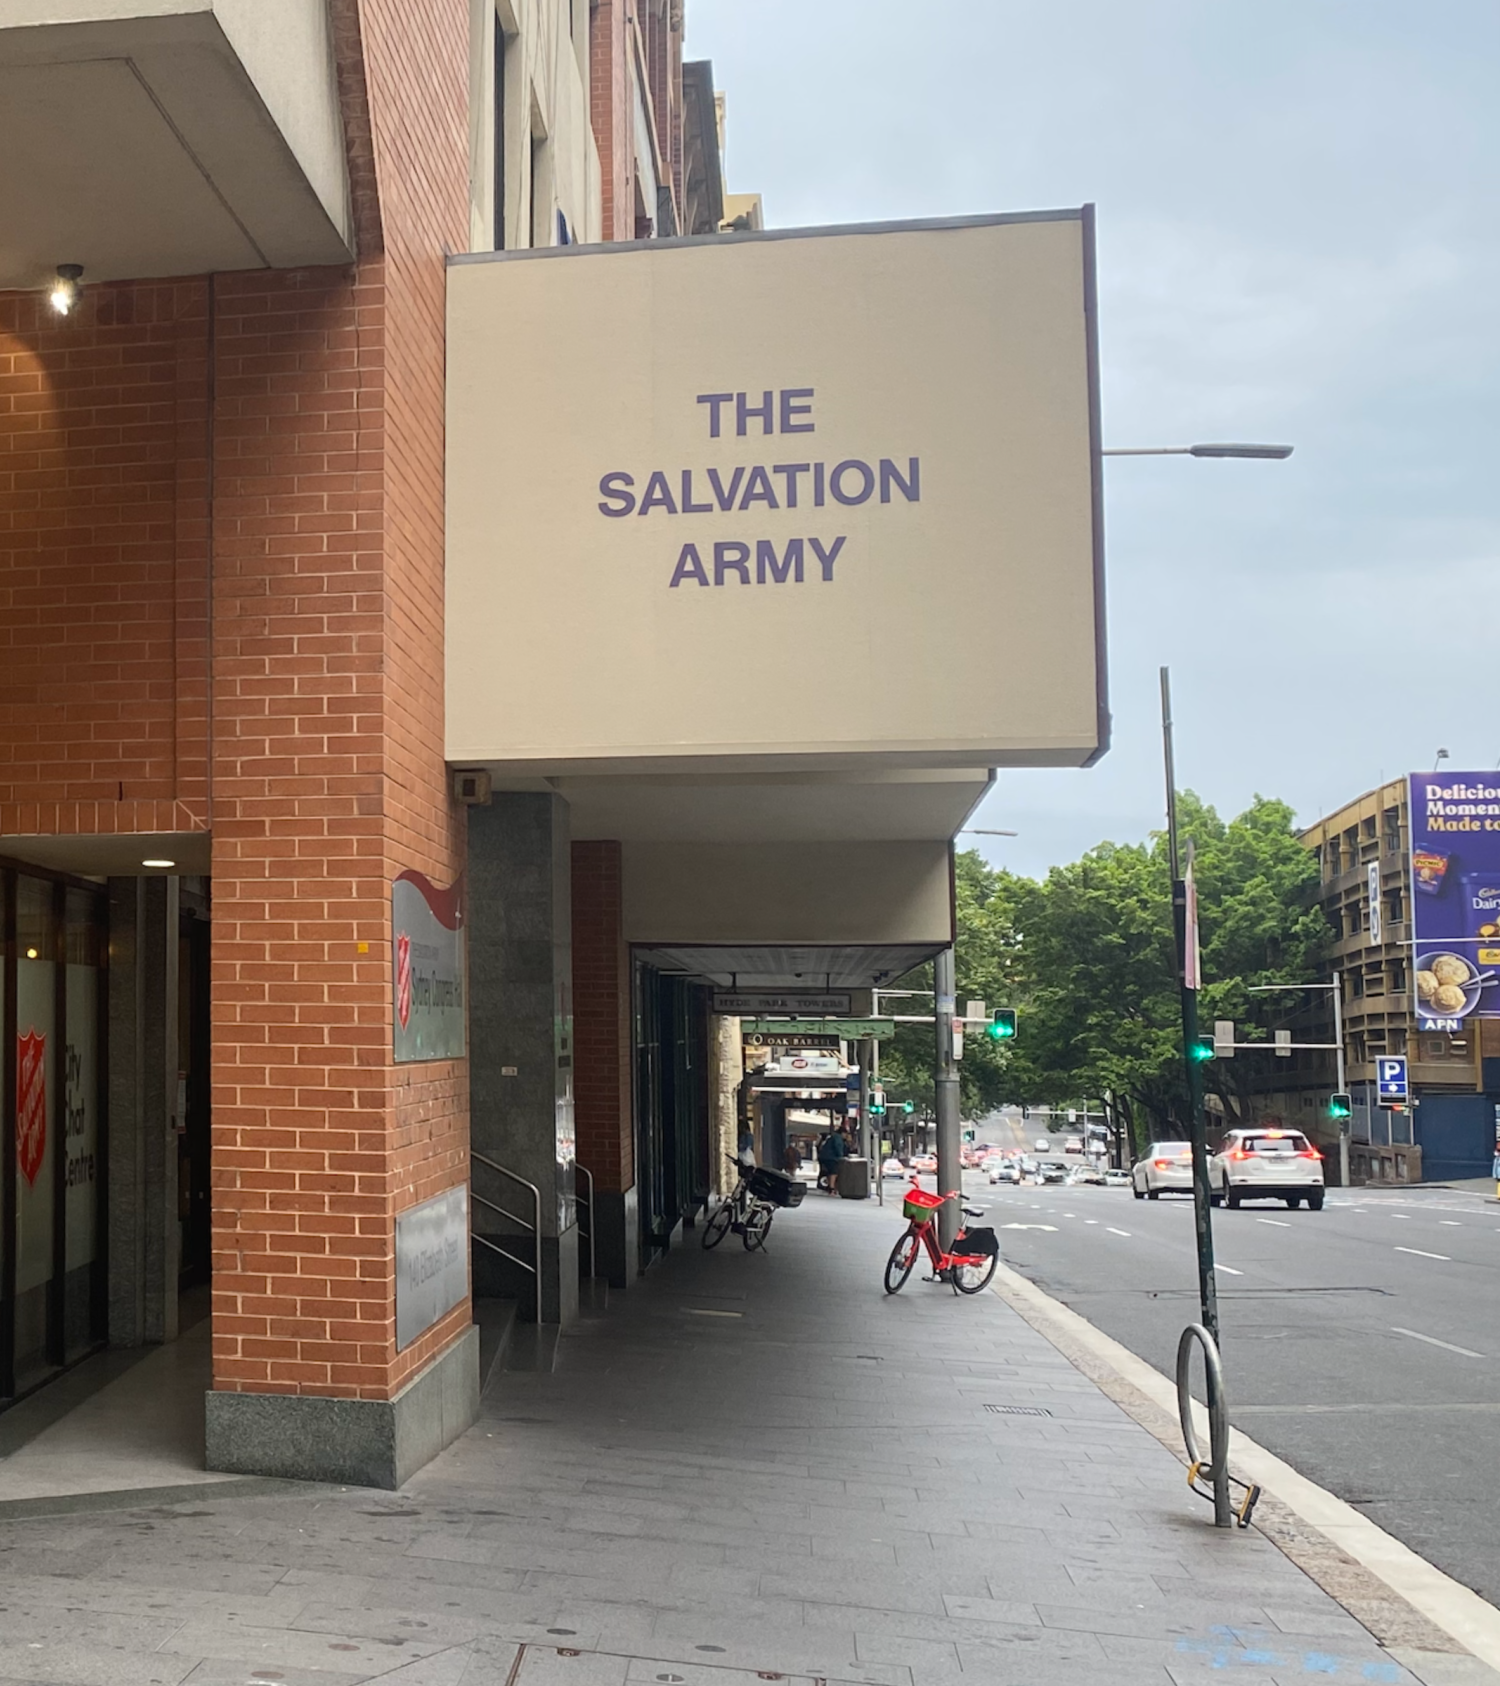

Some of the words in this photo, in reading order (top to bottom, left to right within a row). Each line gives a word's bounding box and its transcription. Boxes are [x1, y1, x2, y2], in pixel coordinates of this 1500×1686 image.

[696, 388, 815, 438] THE
[597, 456, 920, 518] SALVATION
[668, 536, 847, 588] ARMY
[1426, 800, 1500, 816] Momen
[1427, 816, 1481, 831] Made
[719, 999, 751, 1007] HYDE
[758, 999, 788, 1007] PARK
[795, 999, 844, 1008] TOWERS
[767, 1037, 789, 1046] OAK
[793, 1037, 831, 1046] BARREL
[1384, 1061, 1401, 1080] P
